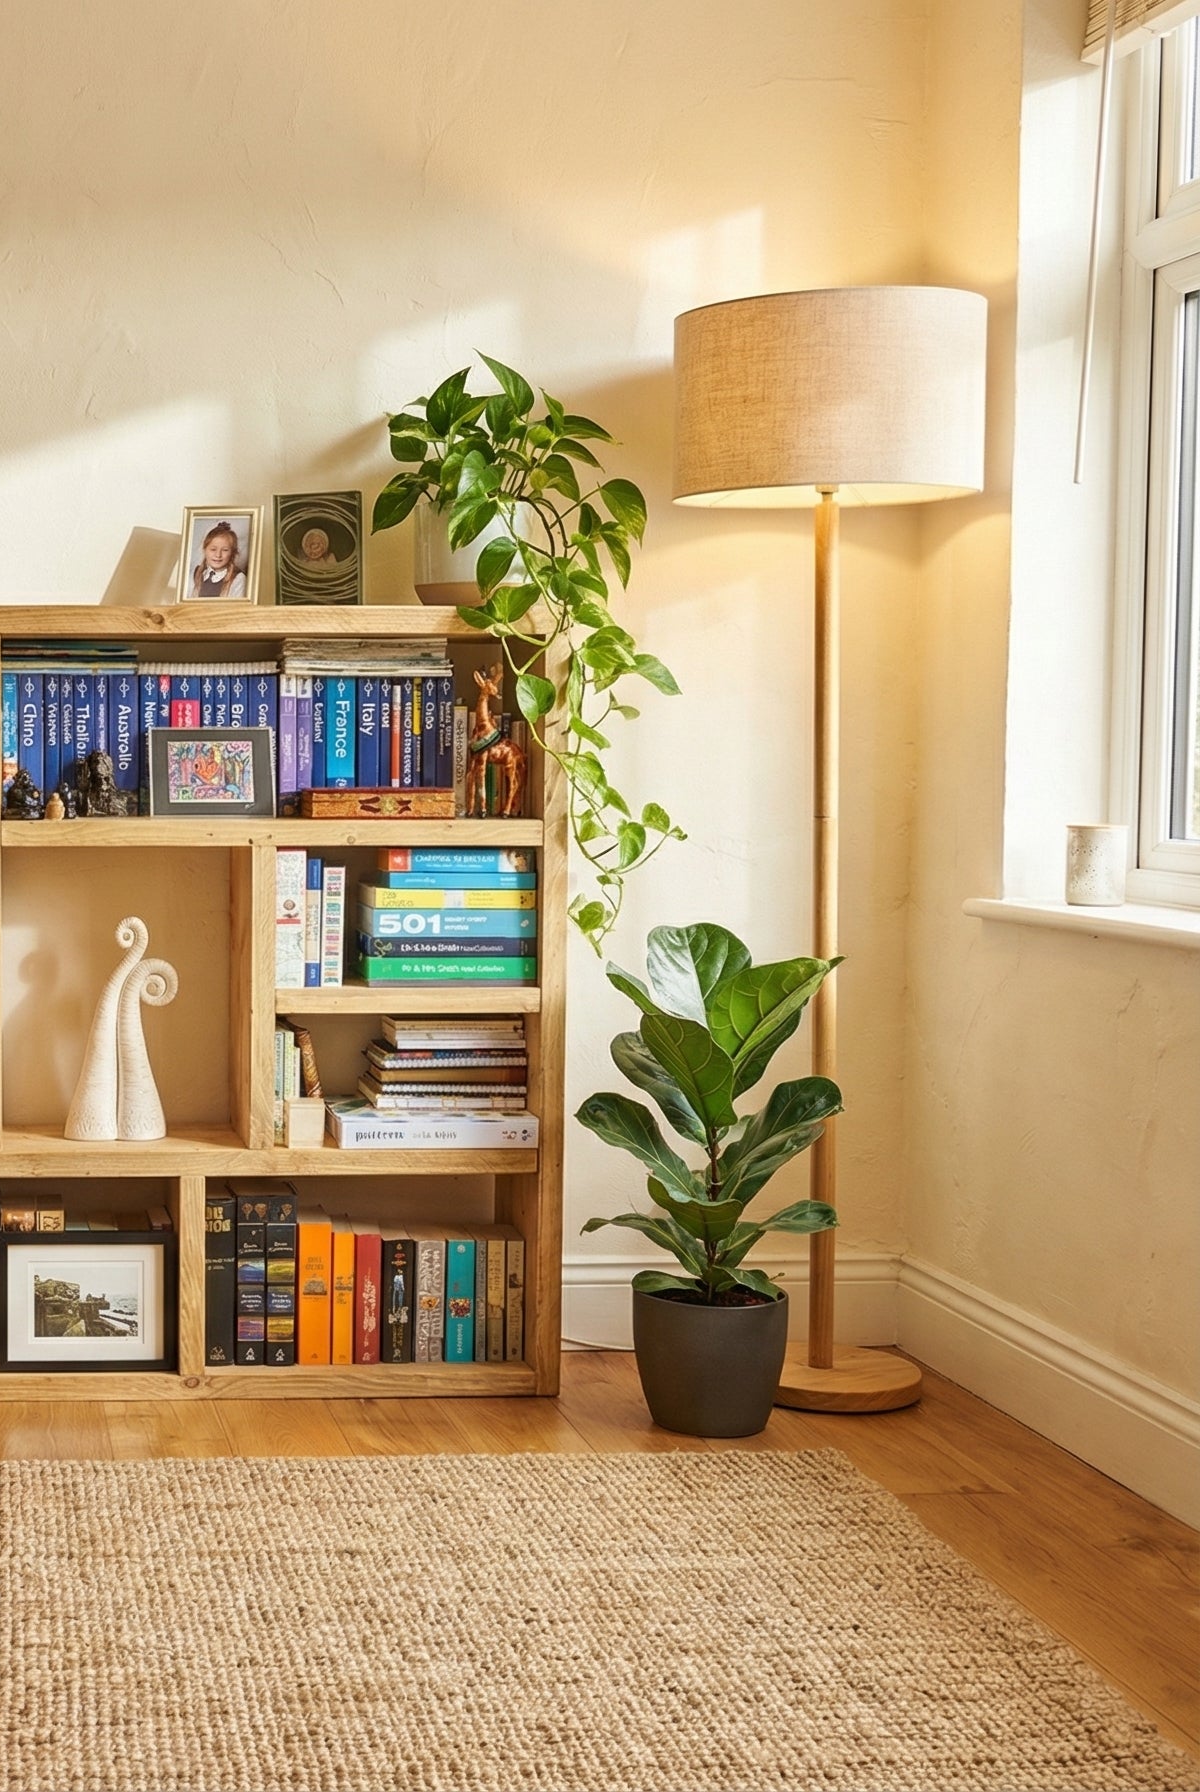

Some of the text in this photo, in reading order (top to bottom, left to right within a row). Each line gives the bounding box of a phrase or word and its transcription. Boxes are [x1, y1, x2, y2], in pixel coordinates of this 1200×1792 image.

[335, 700, 350, 758] France
[359, 703, 376, 736] Italy
[379, 913, 441, 934] 501
